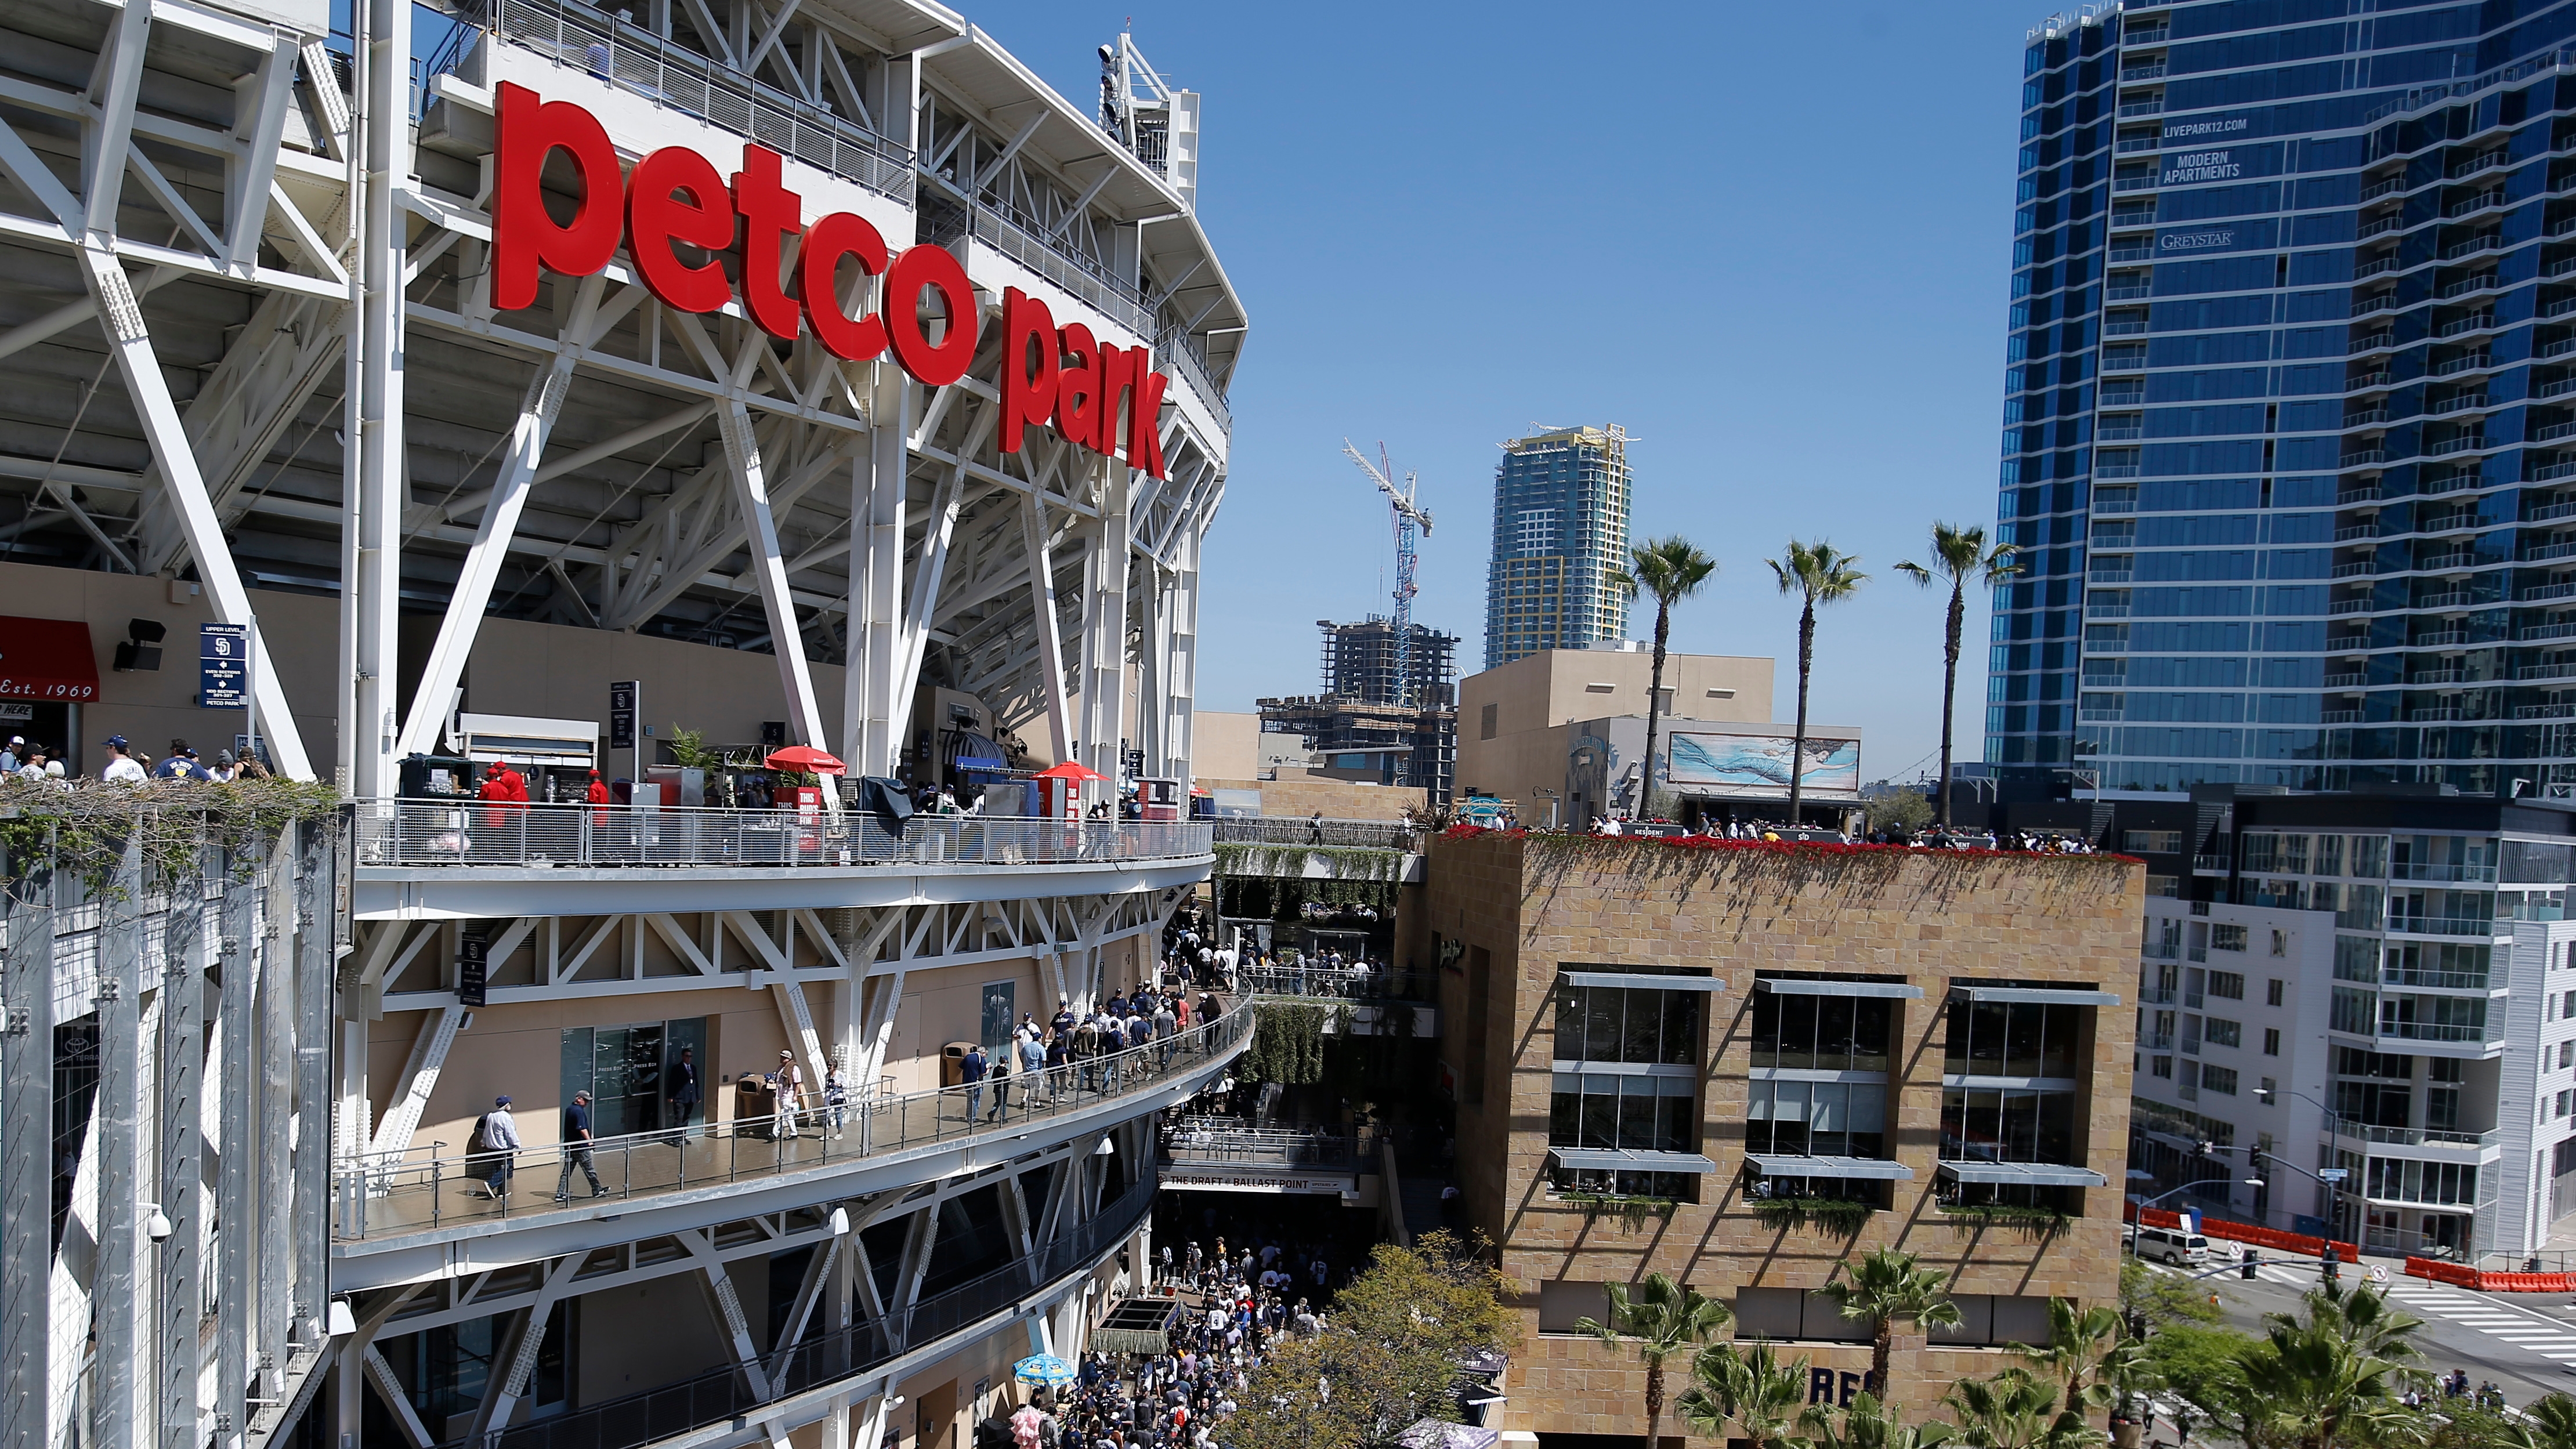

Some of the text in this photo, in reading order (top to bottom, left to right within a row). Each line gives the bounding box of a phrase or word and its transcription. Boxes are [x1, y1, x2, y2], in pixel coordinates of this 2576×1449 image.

[2163, 119, 2247, 137] LIVEPARK12.COM
[2177, 151, 2228, 168] MODERN
[2163, 164, 2240, 183] APARTMENTS
[491, 81, 1168, 480] petco park
[0, 679, 92, 698] Est. 1969
[4, 704, 31, 715] HERE
[799, 792, 815, 803] THIS
[1068, 788, 1077, 798] THIS
[799, 804, 819, 815] BUD'S
[799, 817, 812, 825] FOR
[1170, 1176, 1188, 1185] THE
[1191, 1176, 1223, 1186] DRAFT
[1233, 1178, 1277, 1188] BALLAST
[1279, 1179, 1309, 1189] POINT
